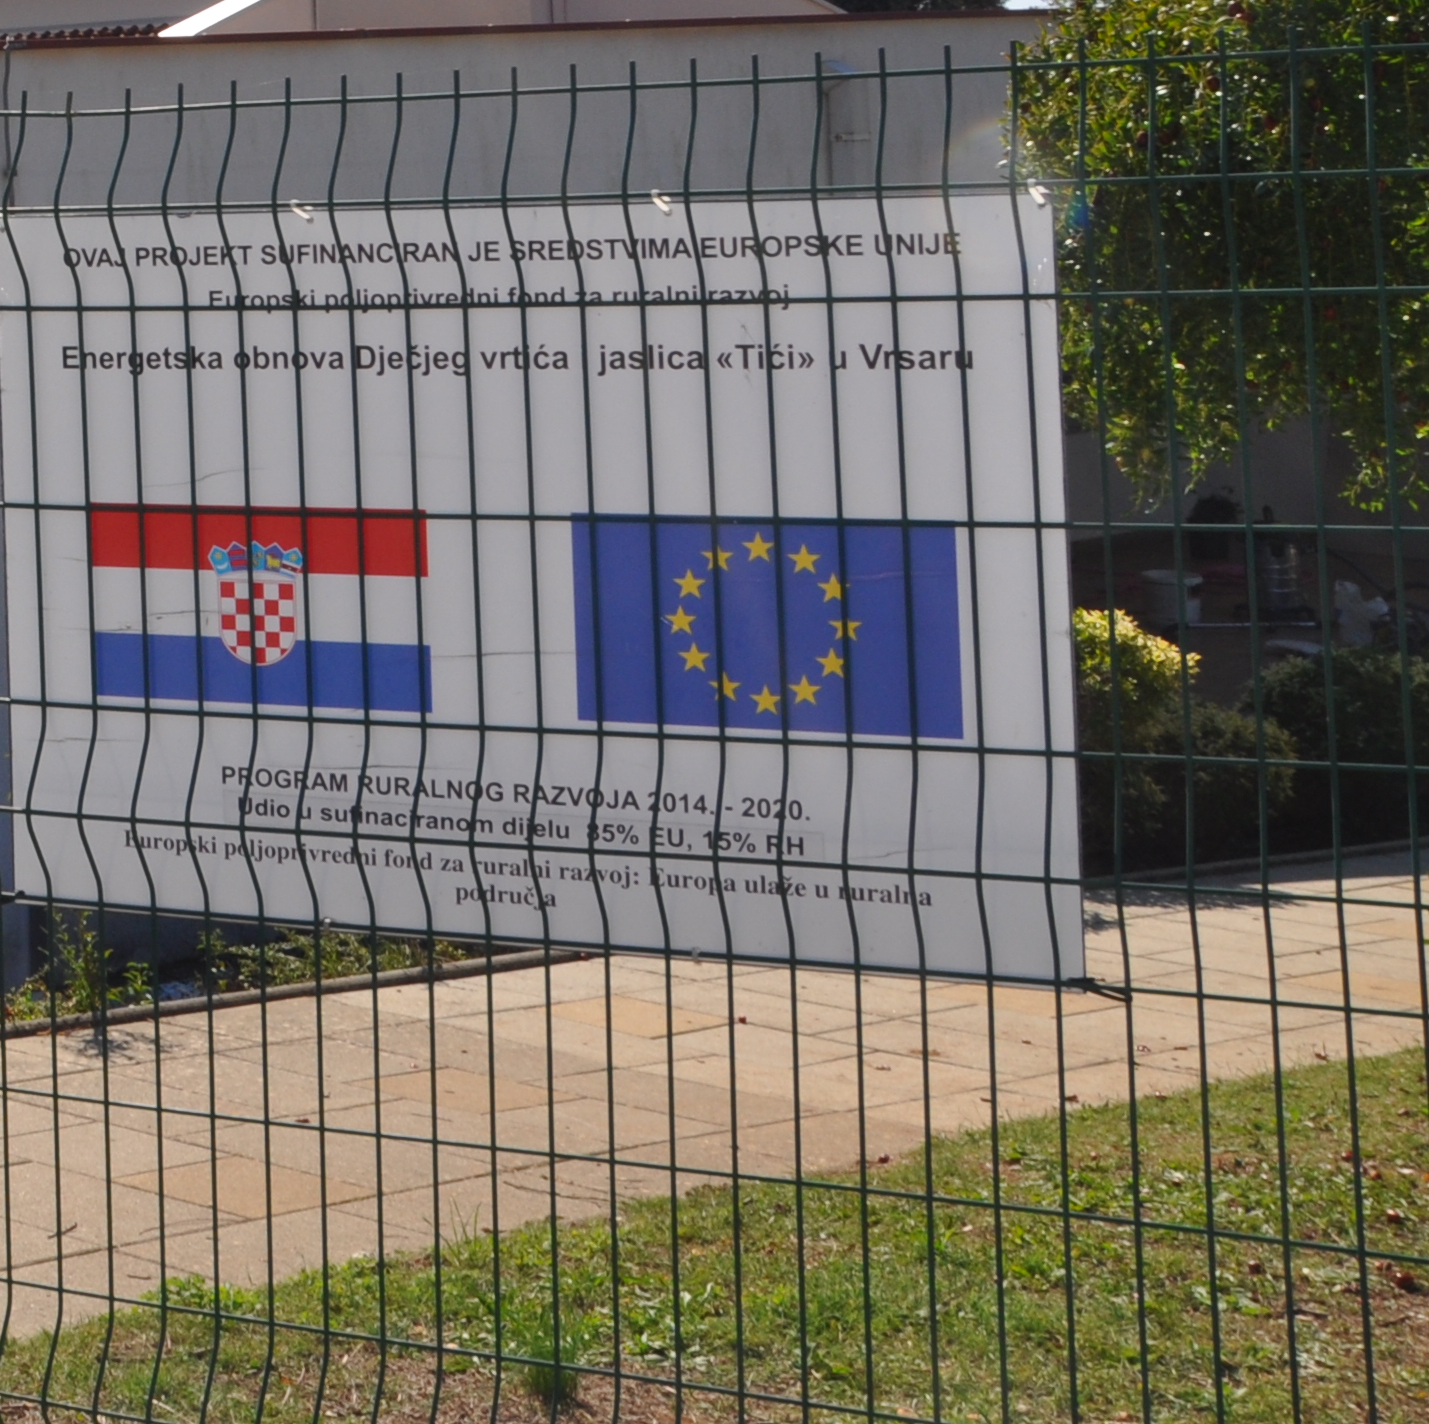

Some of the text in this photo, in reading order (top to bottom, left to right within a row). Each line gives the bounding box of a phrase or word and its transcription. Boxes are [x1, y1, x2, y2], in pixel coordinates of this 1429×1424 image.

[63, 247, 126, 268] OVAJ
[135, 245, 253, 267] PROJEKT
[467, 241, 501, 262] JE
[509, 237, 692, 260] SREDSTVIMA
[701, 234, 864, 258] EUROPSKE
[874, 232, 962, 256] UNIJE
[62, 345, 223, 376] Energetska
[234, 345, 344, 370] obnova
[356, 344, 469, 377] Dječjeg
[598, 343, 704, 376] jaslica
[716, 342, 816, 371] «Tići»
[859, 343, 974, 371] Vrsaru
[221, 765, 349, 793] PROGRAM
[360, 774, 504, 802] RURALNOG
[513, 783, 641, 811] RAZVOJA
[647, 791, 715, 815] 2014.
[741, 797, 811, 821] 2020.
[238, 796, 290, 818] Udio
[320, 804, 493, 834] sufinacranom
[502, 816, 570, 842] dijelu
[650, 825, 692, 851] EU,
[702, 830, 756, 854] 15%
[766, 834, 805, 856] RH
[124, 829, 217, 857] Europski
[440, 856, 464, 873] za
[648, 867, 736, 896] Europa
[744, 874, 807, 898] ulaže
[815, 883, 830, 899] u
